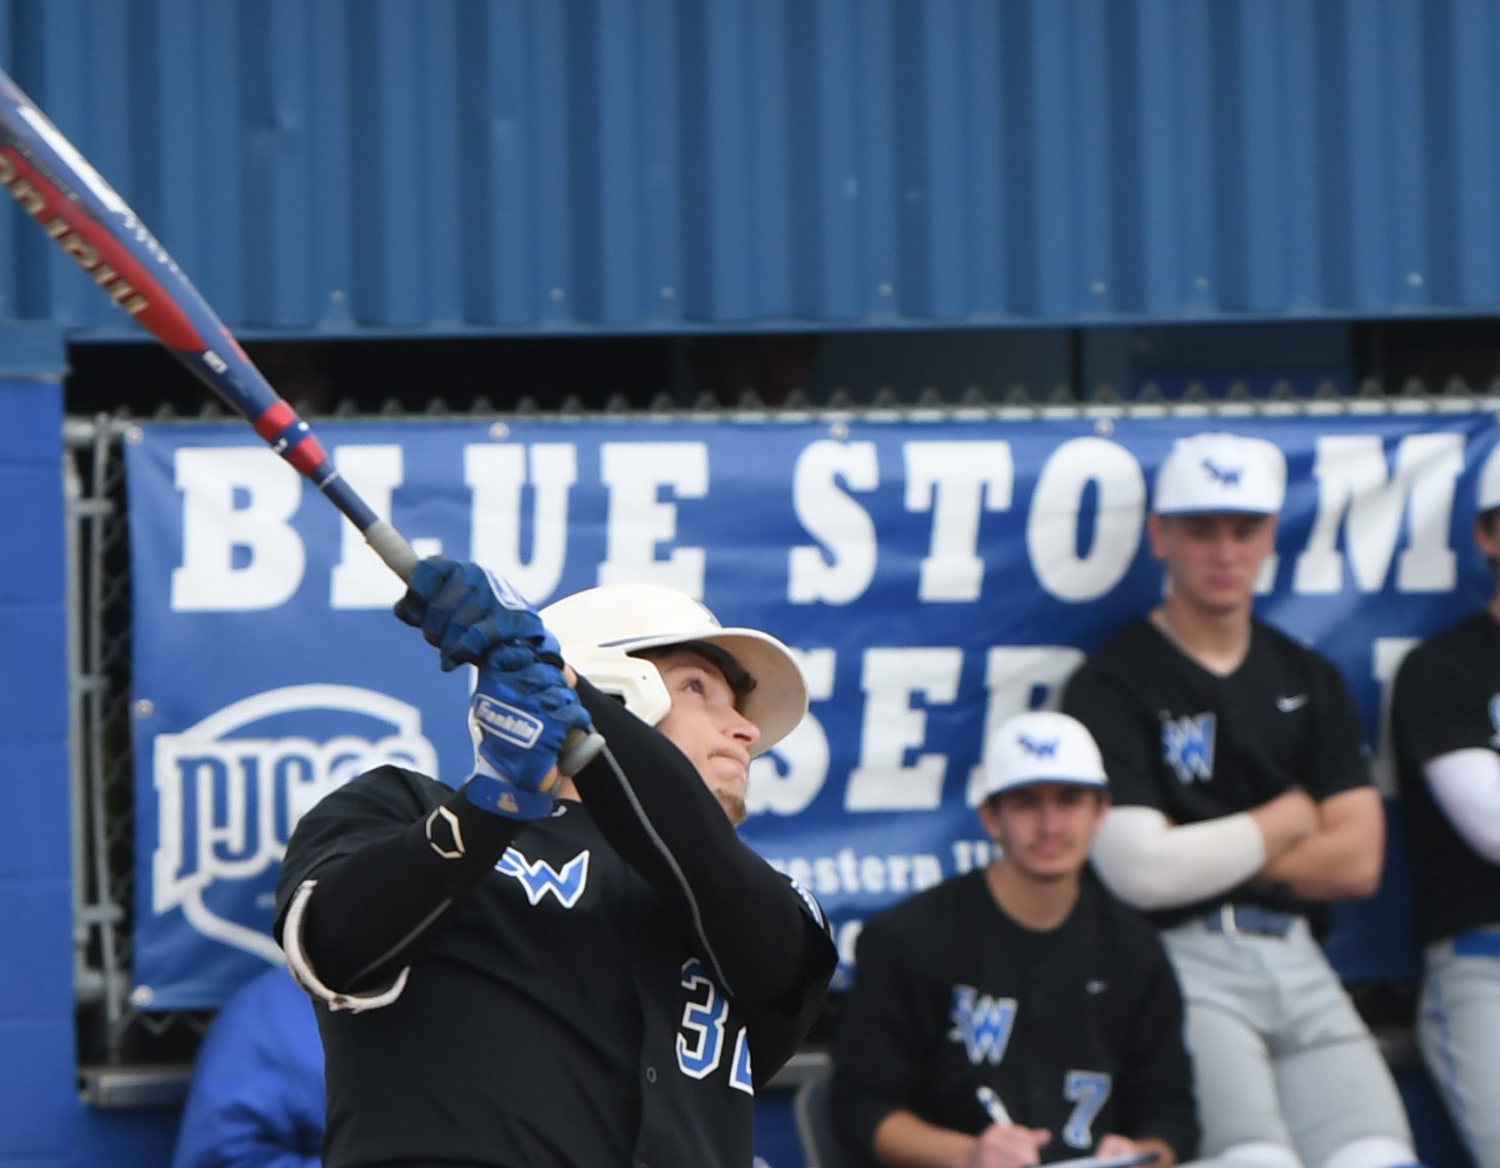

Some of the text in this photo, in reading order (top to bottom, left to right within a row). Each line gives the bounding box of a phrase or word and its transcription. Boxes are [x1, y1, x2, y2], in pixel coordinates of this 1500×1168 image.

[171, 432, 1467, 611] BLUE STOM
[1062, 1068, 1112, 1150] 7
